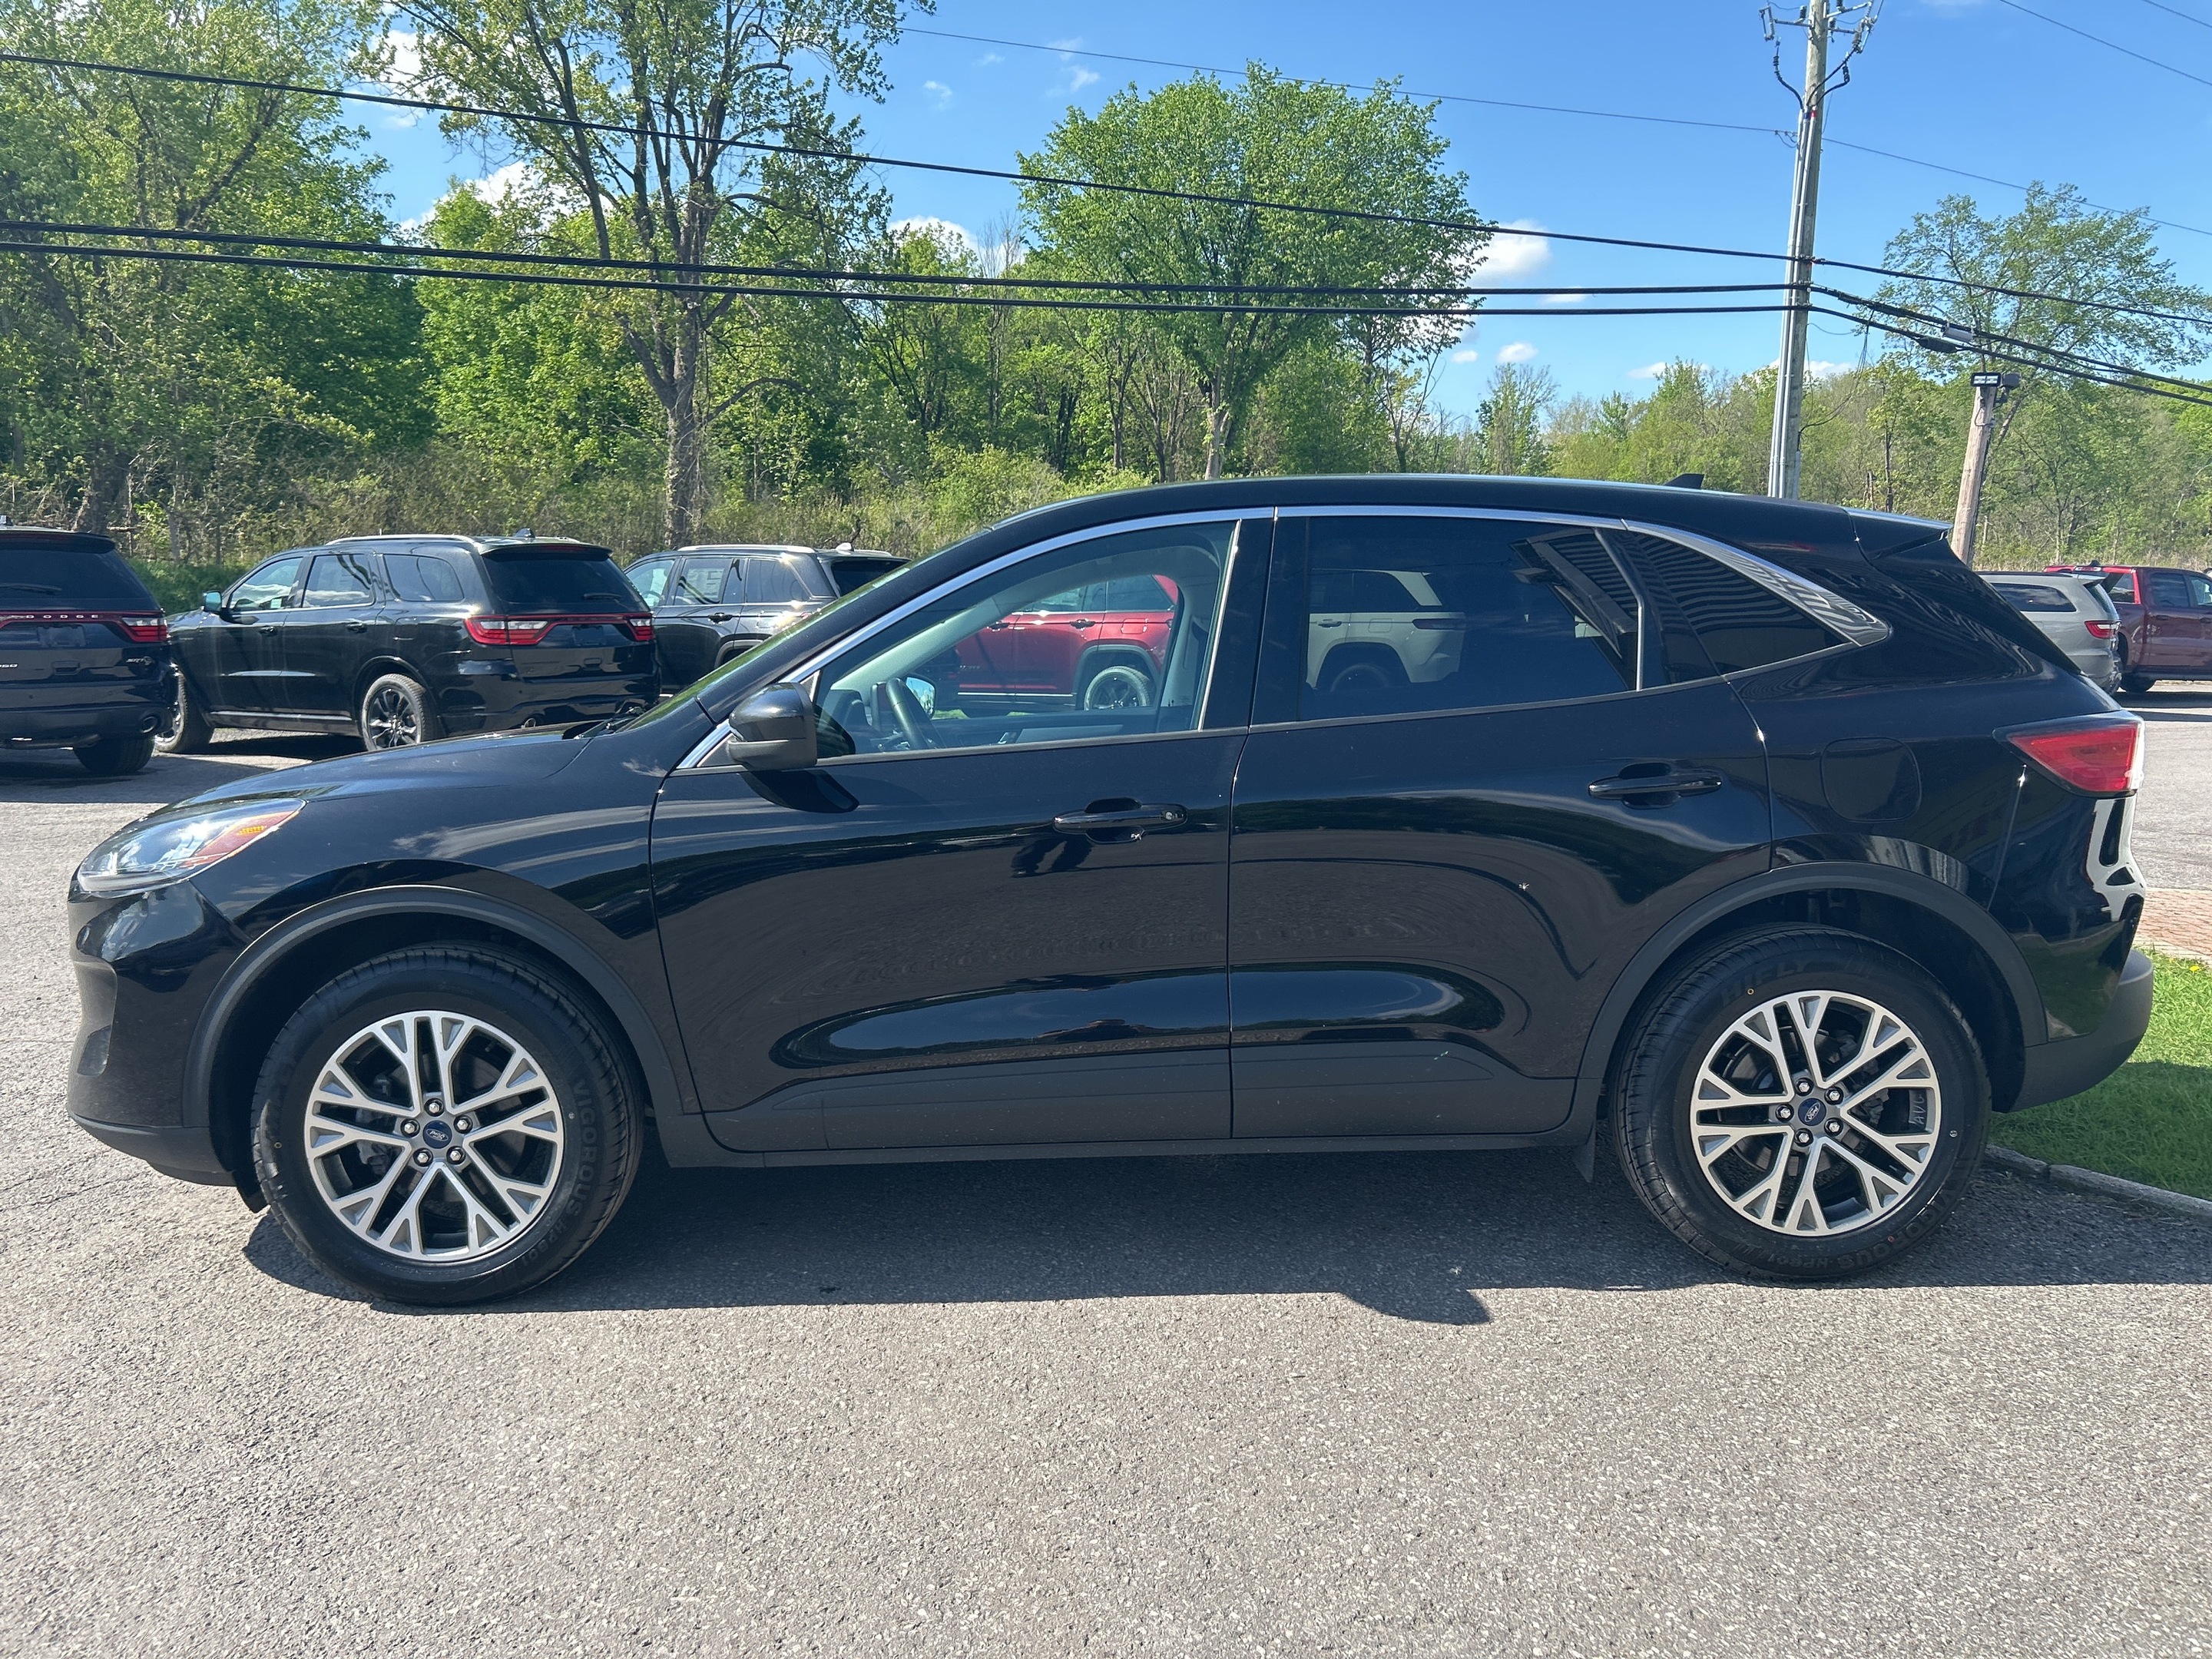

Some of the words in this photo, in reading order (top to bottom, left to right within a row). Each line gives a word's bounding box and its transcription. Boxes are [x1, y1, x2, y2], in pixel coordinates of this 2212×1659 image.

[429, 1130, 446, 1140] Ford
[566, 1079, 598, 1217] VIGOROUS
[1837, 1191, 1953, 1269] VIGOROUS
